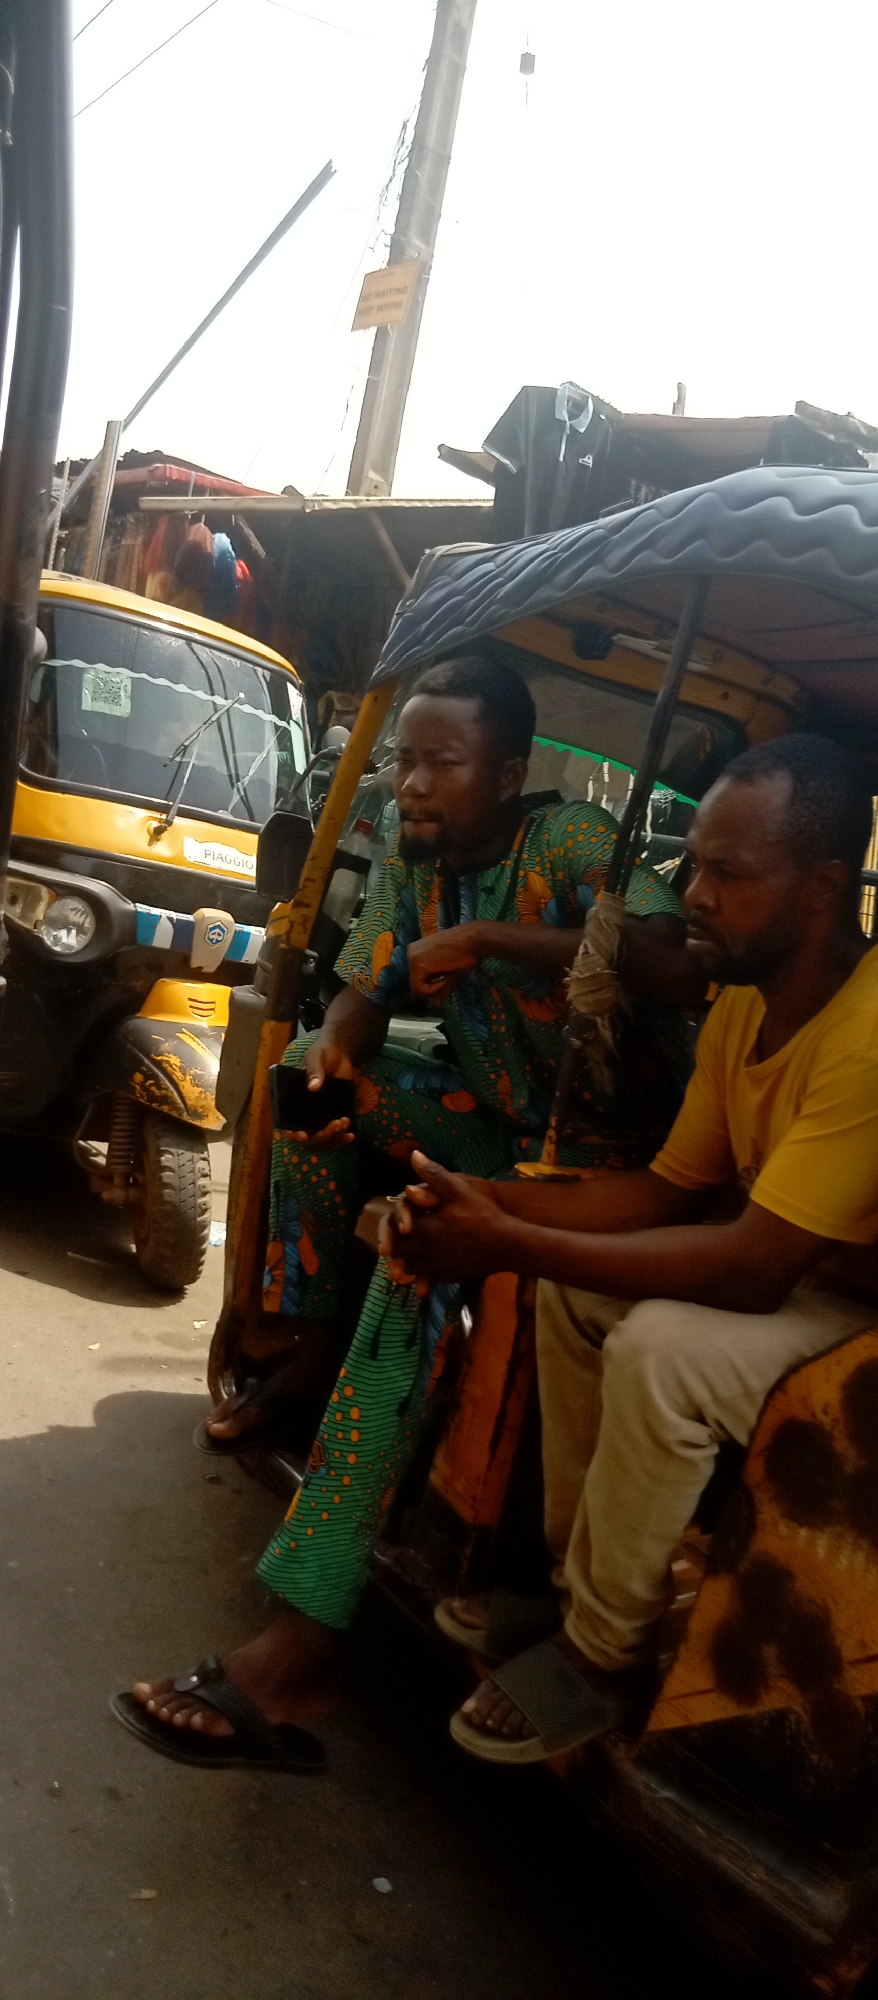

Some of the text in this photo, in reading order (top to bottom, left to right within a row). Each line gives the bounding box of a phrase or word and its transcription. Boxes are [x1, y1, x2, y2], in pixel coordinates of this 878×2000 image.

[374, 286, 408, 298] WAITING
[376, 301, 403, 313] MOVING
[204, 849, 253, 869] PIAGGIO
